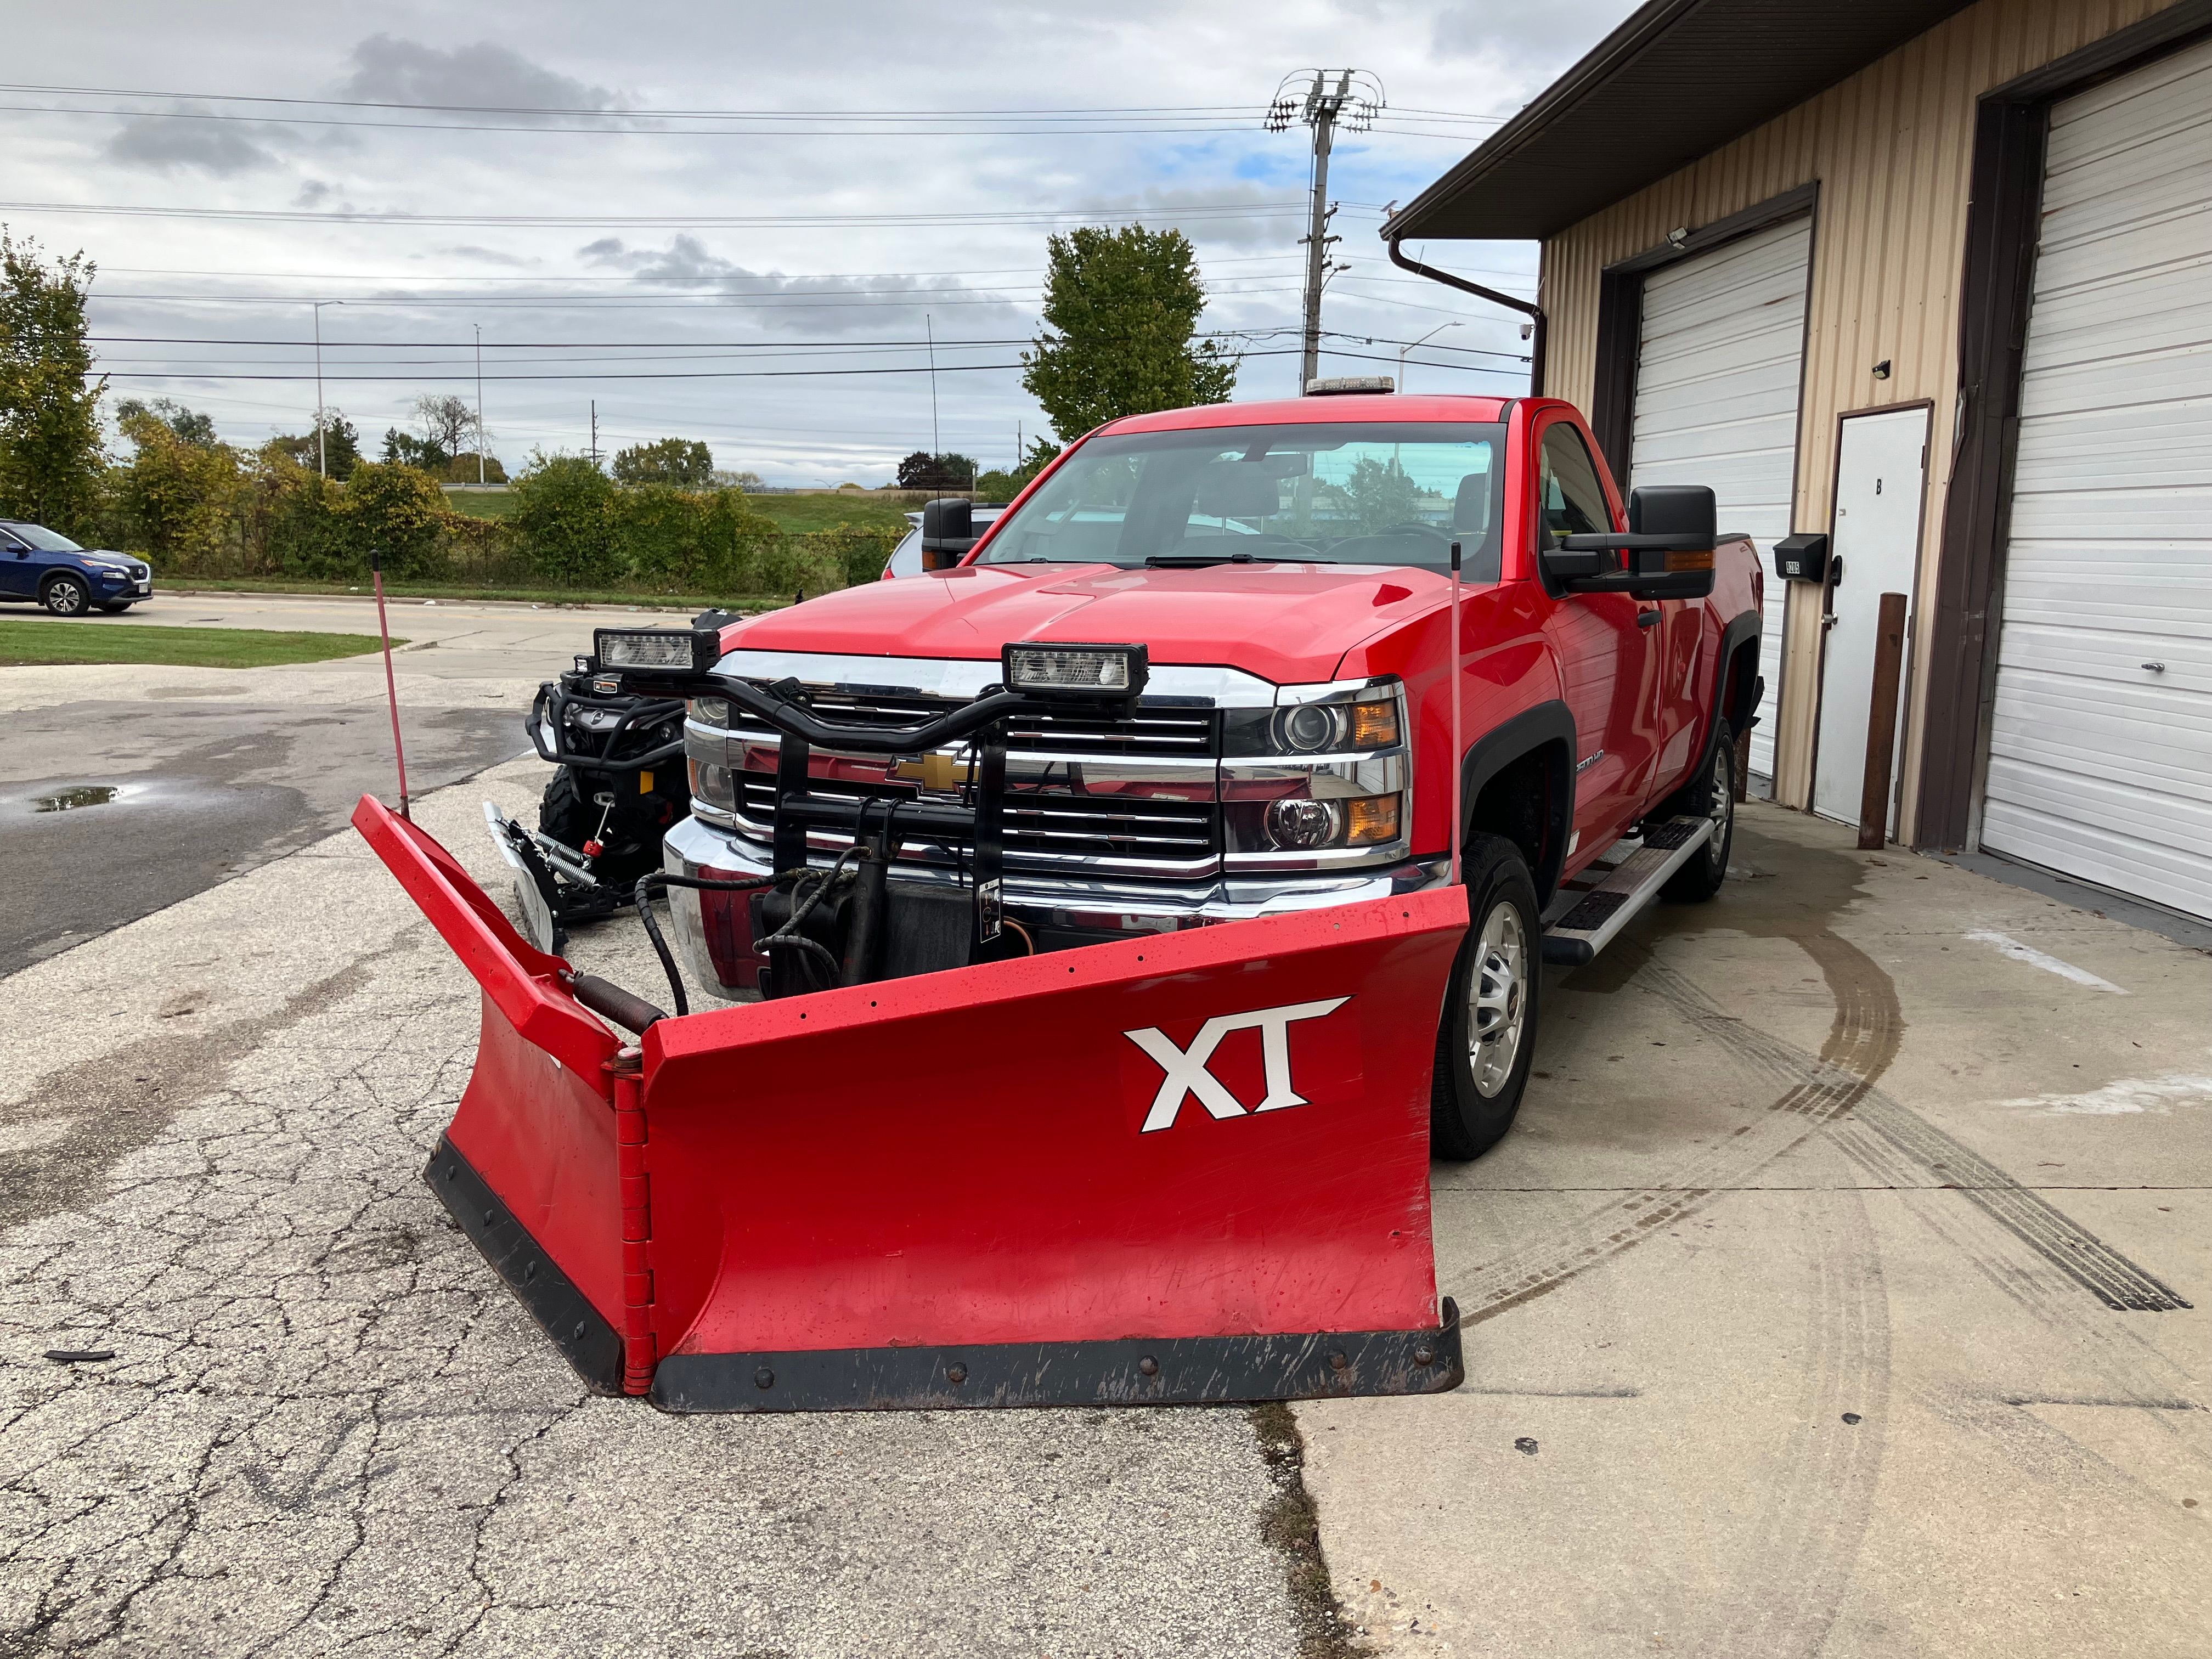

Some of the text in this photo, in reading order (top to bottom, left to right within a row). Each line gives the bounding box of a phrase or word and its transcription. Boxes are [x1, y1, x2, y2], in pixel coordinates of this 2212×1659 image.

[1876, 478, 1882, 494] B
[1786, 562, 1799, 573] 9205
[1121, 994, 1356, 1134] XT
